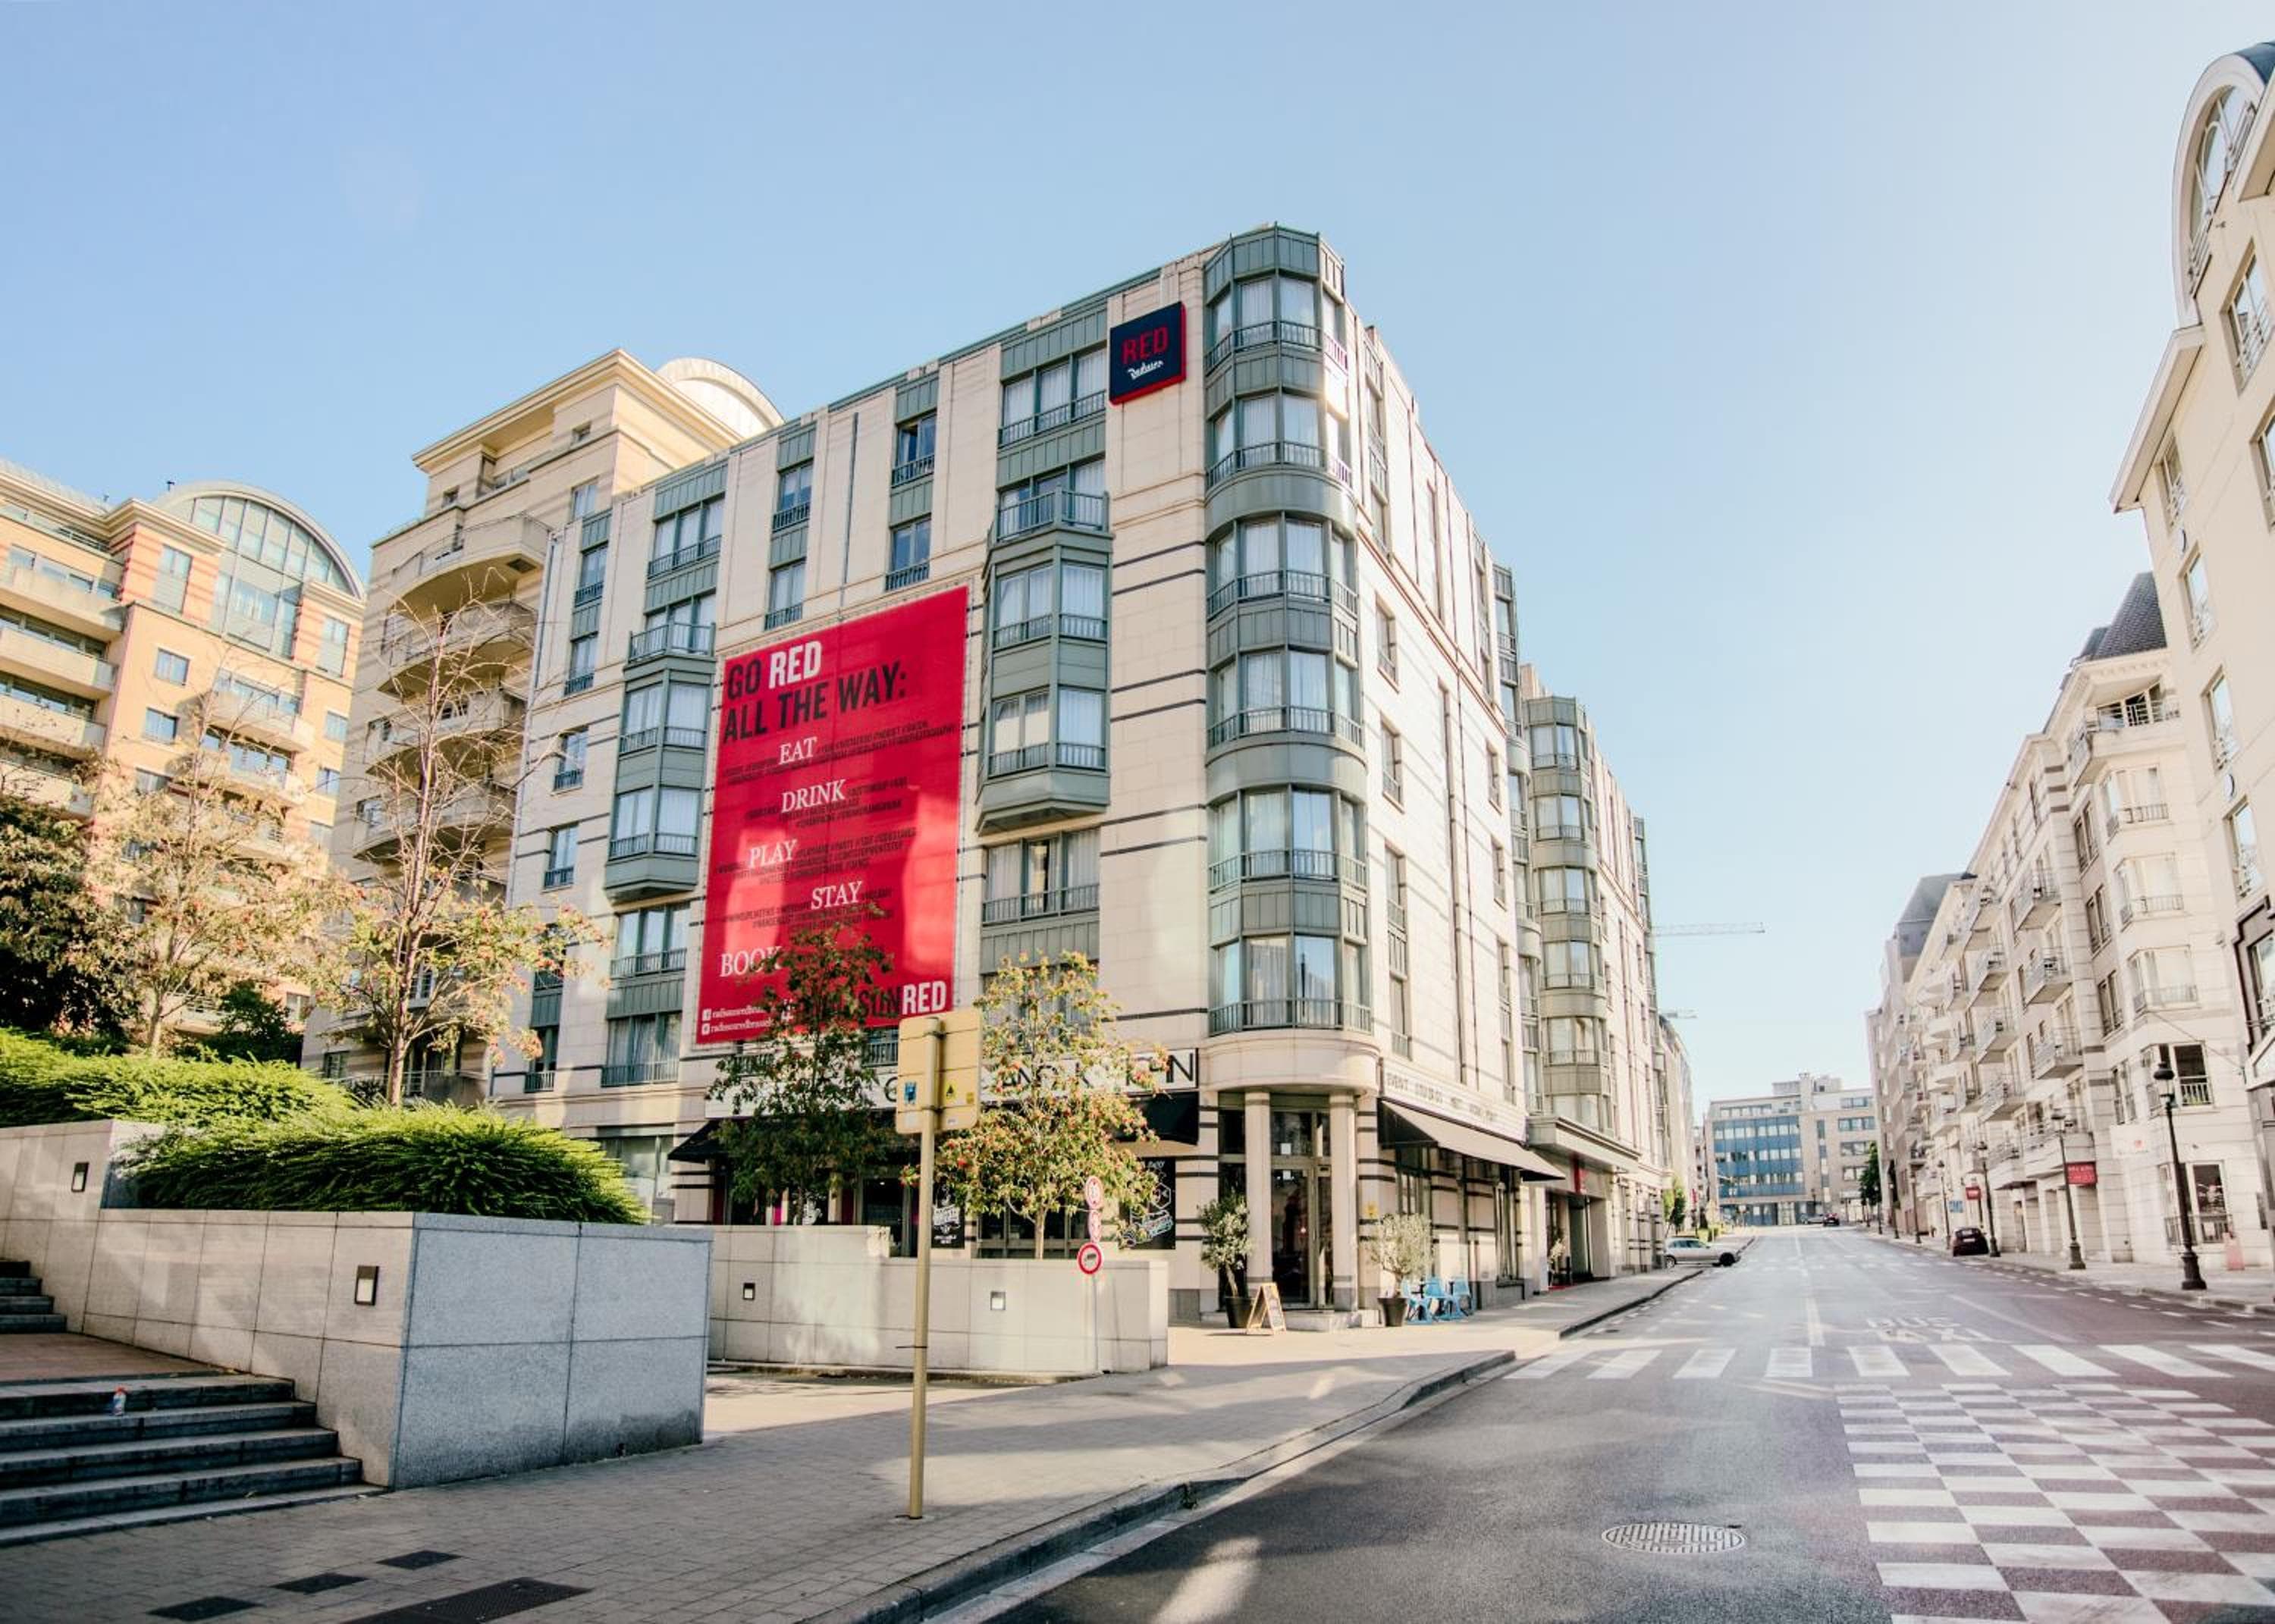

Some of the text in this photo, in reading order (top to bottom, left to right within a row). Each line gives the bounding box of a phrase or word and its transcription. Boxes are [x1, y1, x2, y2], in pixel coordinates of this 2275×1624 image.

[1122, 324, 1169, 365] RED
[726, 640, 822, 700] GO RED
[723, 706, 767, 745] ALL
[777, 681, 829, 729] THE
[837, 660, 907, 713] WAY:
[778, 736, 817, 765] EAT
[780, 779, 847, 814] DRINK
[748, 839, 798, 869] PLAY
[811, 880, 863, 911] STAY
